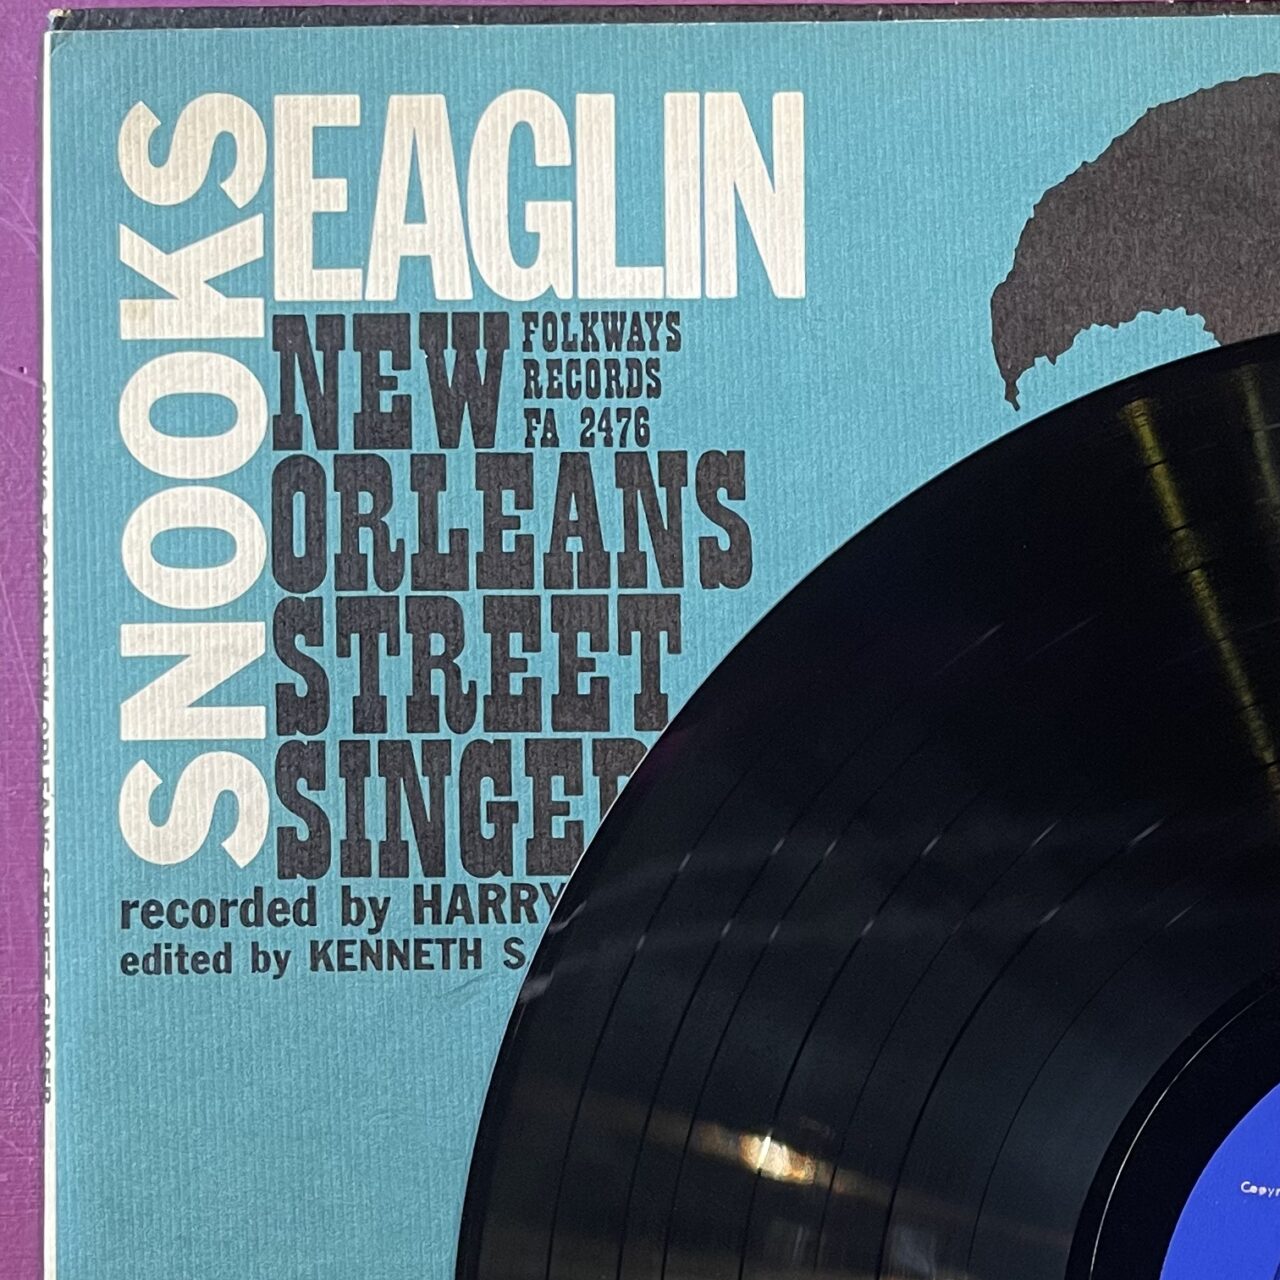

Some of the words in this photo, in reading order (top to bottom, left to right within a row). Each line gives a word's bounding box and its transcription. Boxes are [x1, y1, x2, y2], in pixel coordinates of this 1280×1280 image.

[273, 89, 806, 301] EAGLIN
[522, 311, 682, 353] FOLKWAYS
[272, 312, 510, 450] NEW
[522, 359, 663, 400] RECORDS
[524, 407, 560, 448] FA
[580, 406, 651, 448] 2476
[118, 92, 270, 869] SNOOKS
[271, 451, 754, 592] ORLEANS
[272, 594, 682, 736] STREET
[120, 886, 316, 929] recorded
[341, 885, 390, 934] by
[120, 942, 232, 976] edited
[251, 941, 292, 980] by
[310, 937, 482, 972] KENNETH
